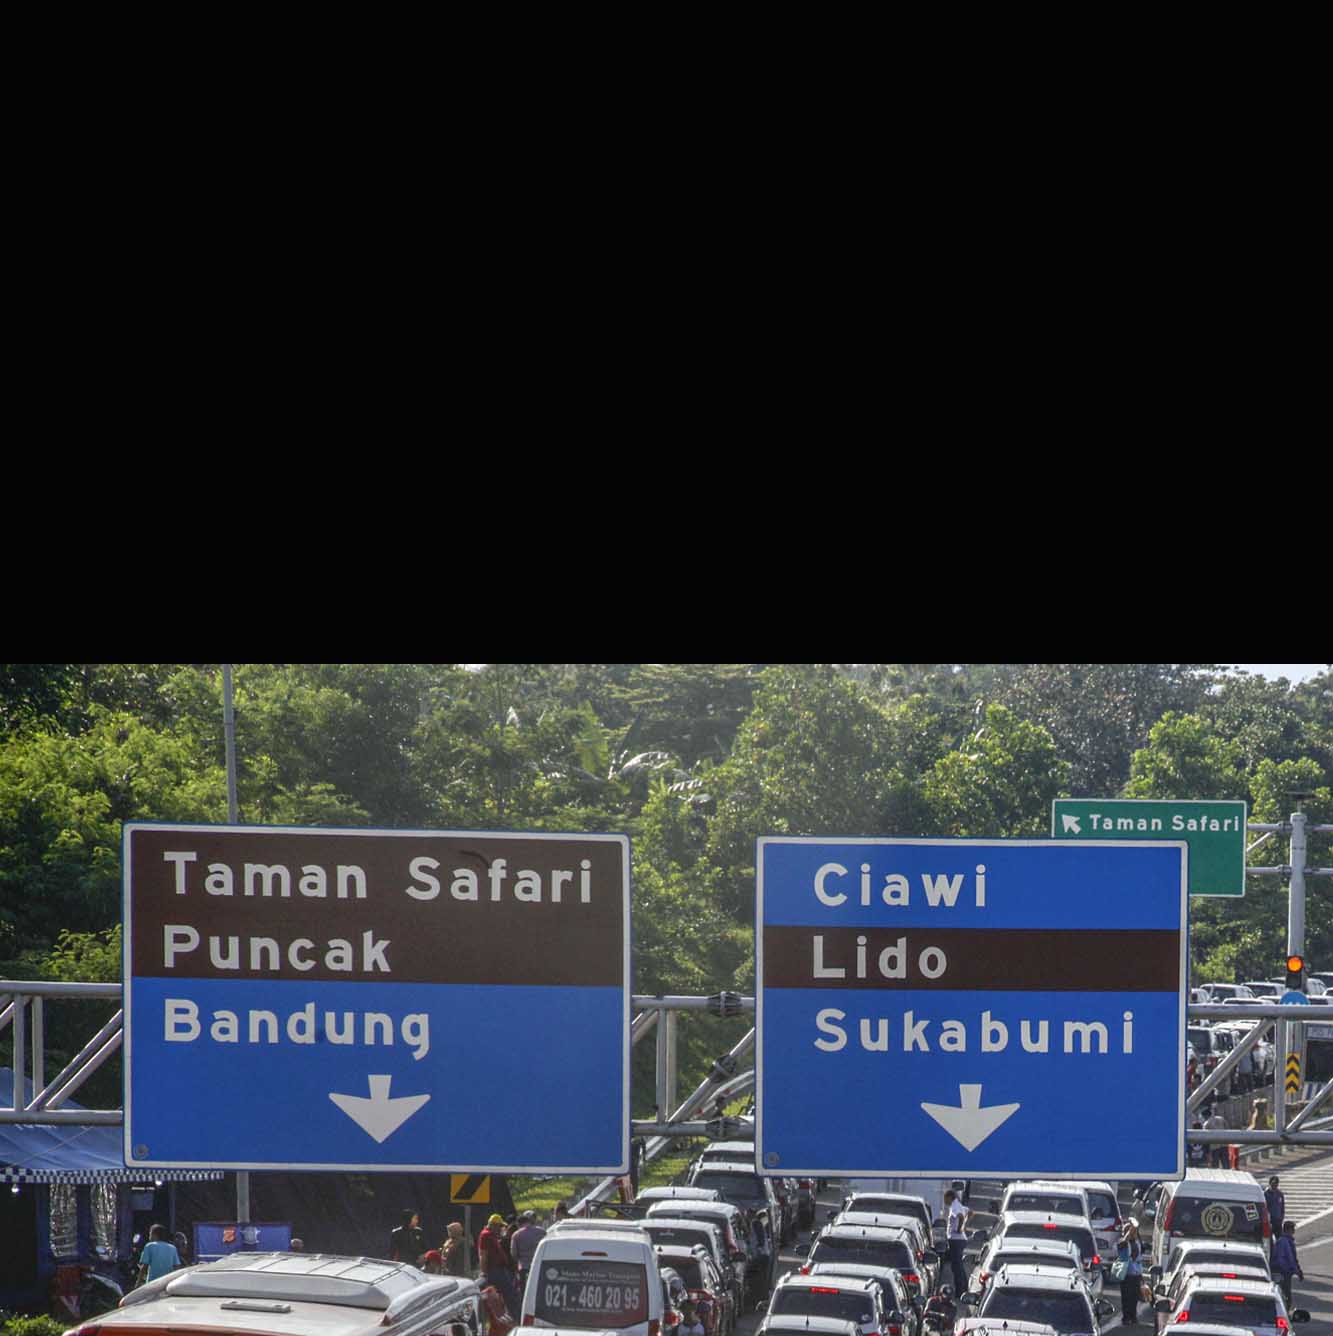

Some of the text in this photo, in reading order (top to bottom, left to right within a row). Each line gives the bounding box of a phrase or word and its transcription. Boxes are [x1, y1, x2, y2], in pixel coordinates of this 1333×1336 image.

[1089, 814, 1239, 832] Taman Safari
[164, 851, 593, 903] Taman Safari
[814, 862, 986, 907] Ciawi
[164, 924, 392, 972] Puncak
[813, 935, 947, 979] Lido
[165, 998, 431, 1060] Bandung
[814, 1008, 1134, 1054] Sukabumi
[545, 1284, 567, 1307] 021
[579, 1286, 602, 1308] 460
[604, 1287, 621, 1308] 20
[624, 1288, 640, 1310] 95
